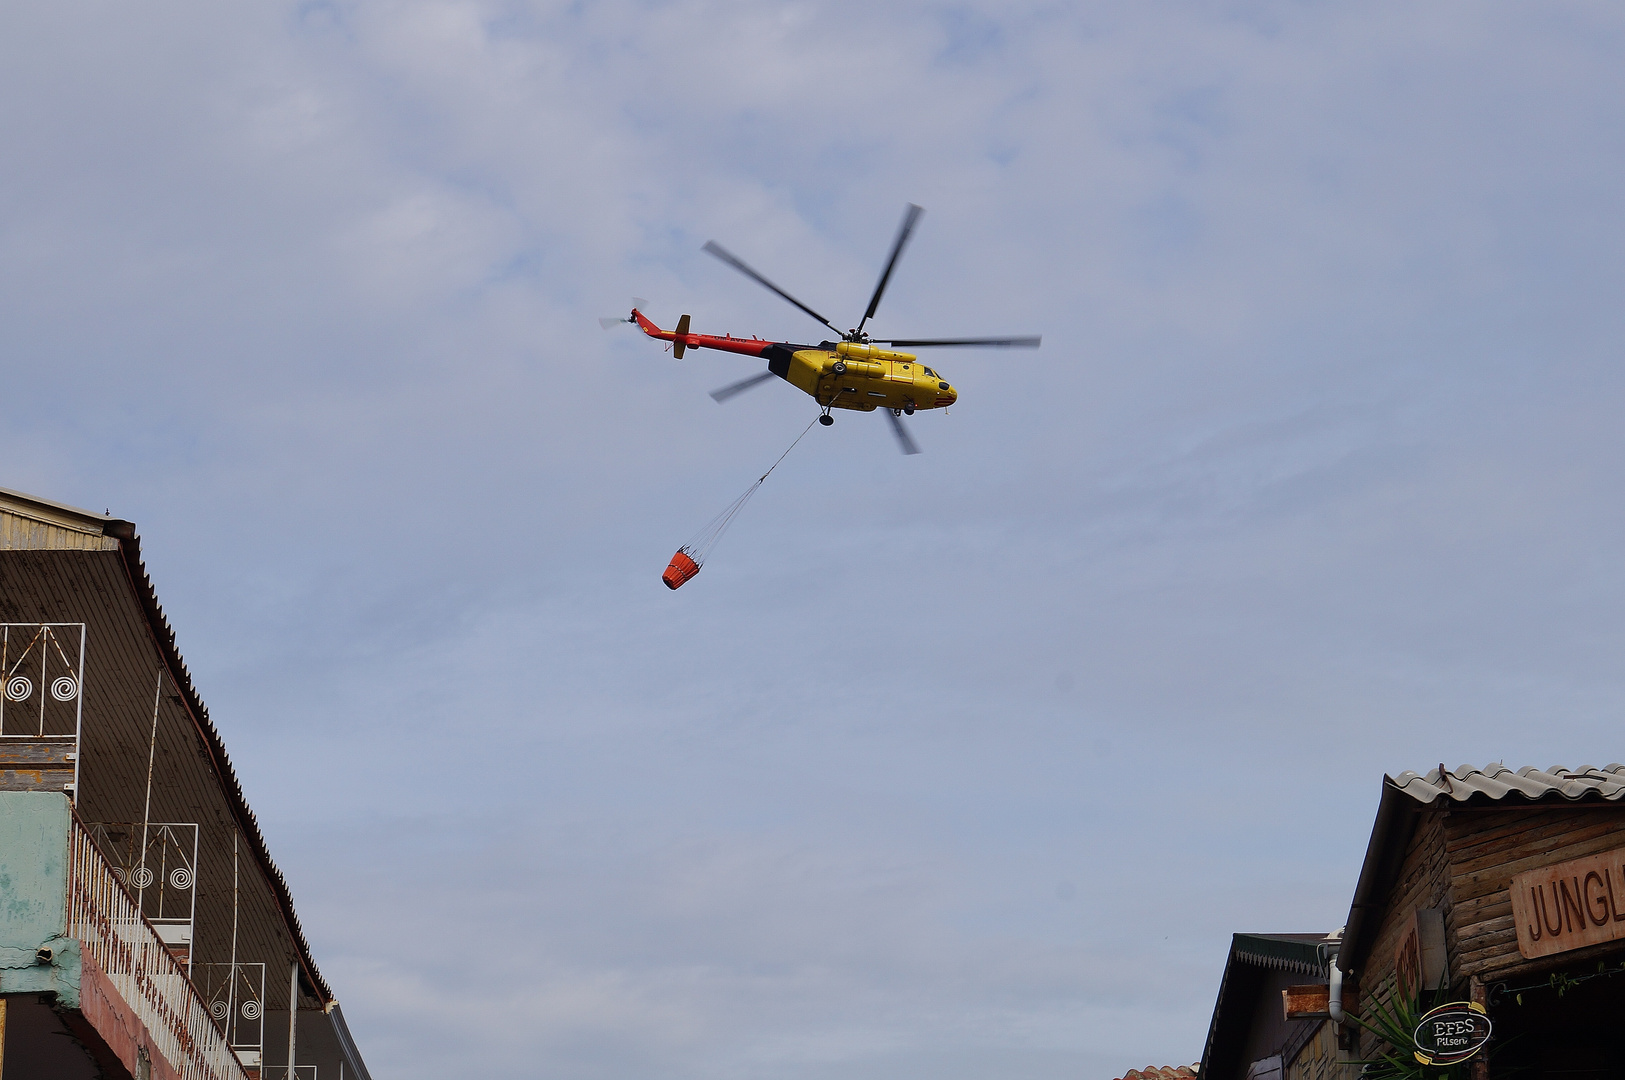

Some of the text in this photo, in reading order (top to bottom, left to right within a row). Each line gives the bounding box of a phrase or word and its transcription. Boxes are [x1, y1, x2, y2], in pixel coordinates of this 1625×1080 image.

[1529, 865, 1625, 941] JUNGL
[1433, 1018, 1475, 1037] EFES
[1436, 1037, 1468, 1047] Pilsen
